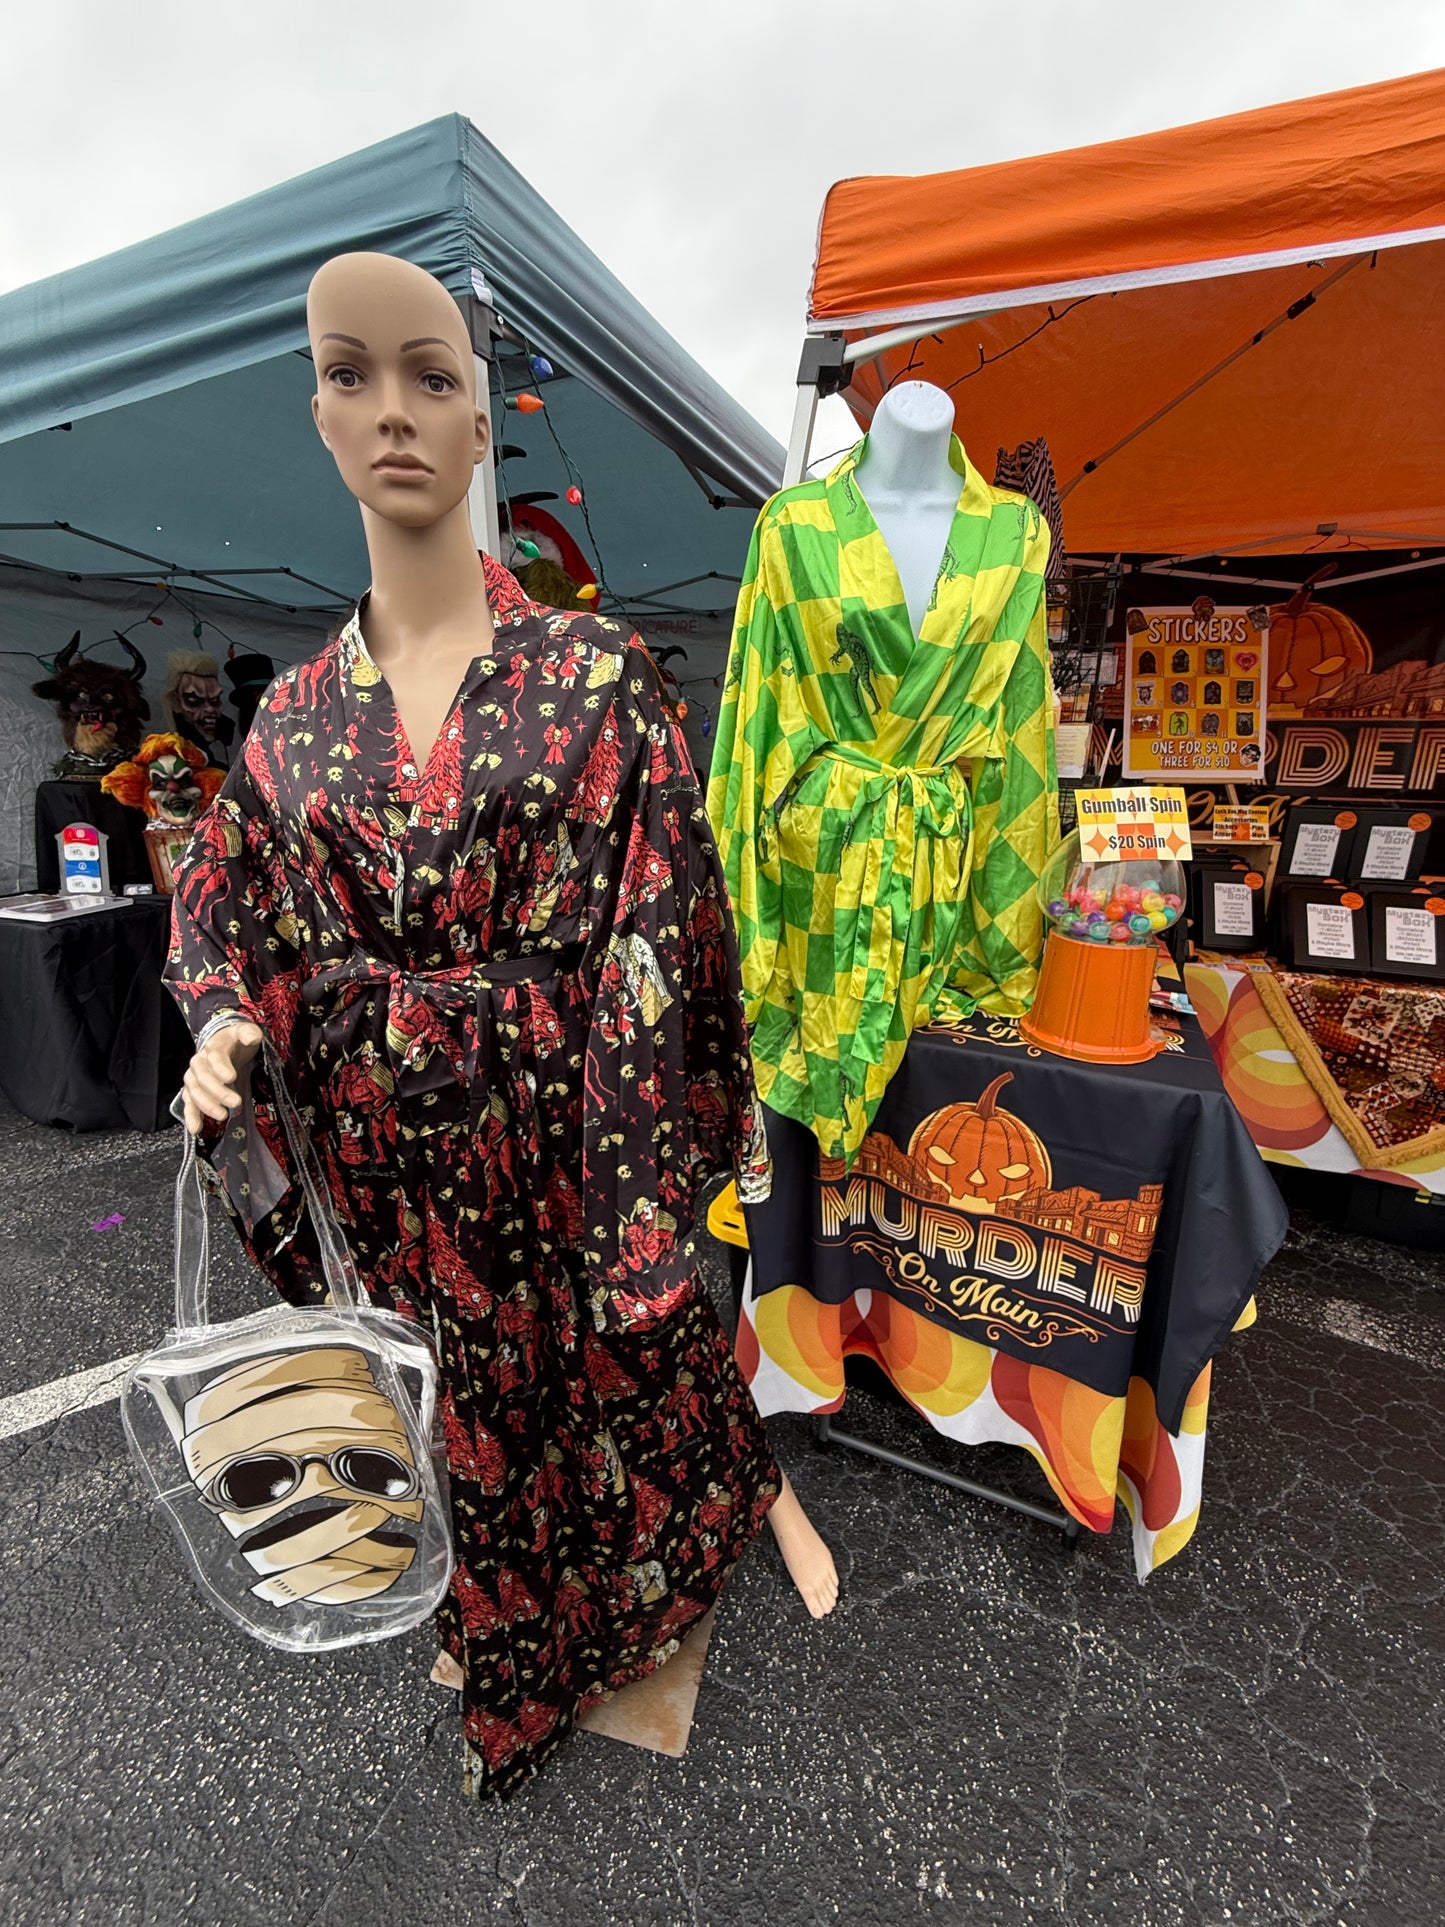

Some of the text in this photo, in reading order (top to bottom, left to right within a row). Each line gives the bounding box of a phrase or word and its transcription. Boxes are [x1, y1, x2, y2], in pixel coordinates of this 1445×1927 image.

[1148, 617, 1248, 643] STICKERS
[1151, 741, 1238, 754] ONE FOR $4 OR
[1159, 756, 1230, 768] THREE FOR $10
[1081, 797, 1182, 814] Gumball Spin
[1300, 827, 1341, 837] Mystery
[1372, 829, 1415, 839] Mystery
[1108, 835, 1166, 850] $20 Spin
[1216, 885, 1251, 894] Mystery
[1308, 906, 1351, 916] Mystery
[1387, 910, 1433, 921] Mystery
[820, 1177, 1147, 1324] MURDER
[895, 1246, 1044, 1329] On Main
